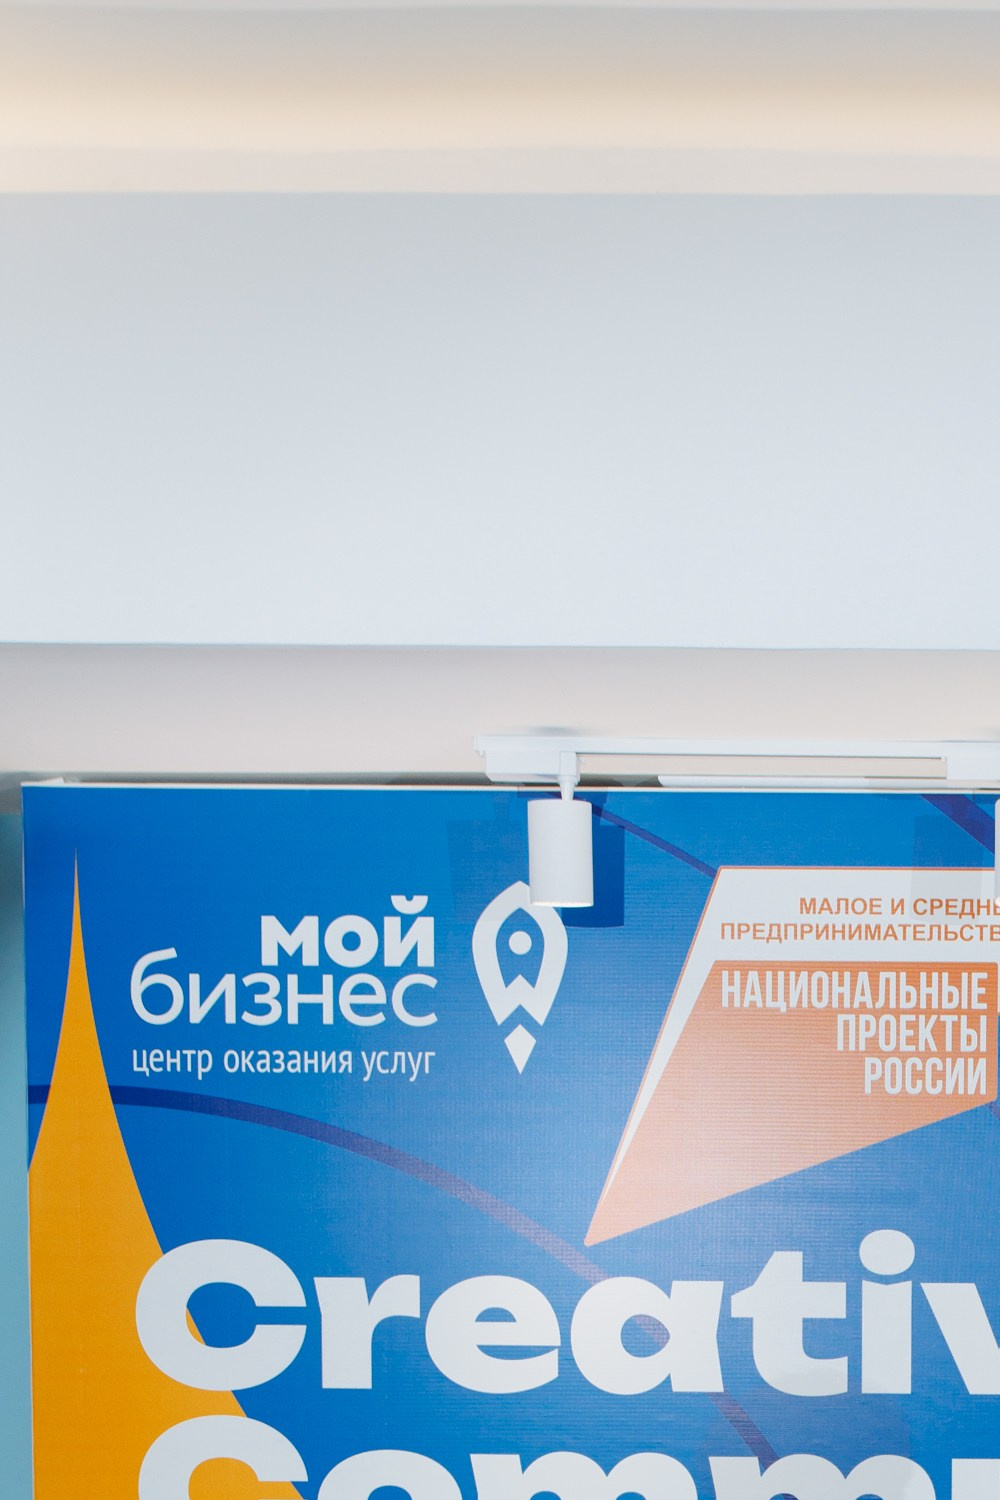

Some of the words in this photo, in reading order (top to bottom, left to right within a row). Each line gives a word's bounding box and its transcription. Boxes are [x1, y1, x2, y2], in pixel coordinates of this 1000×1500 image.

[799, 897, 883, 916] МАЛОЕ
[891, 898, 905, 916] И
[261, 895, 435, 968] мой
[130, 947, 438, 1027] бизнес
[721, 970, 988, 1012] НАЦИОНАЛЬНЫЕ
[837, 1014, 987, 1053] ПРОЕКТЫ
[132, 1048, 213, 1081] центр
[223, 1049, 353, 1074] оказания
[361, 1050, 436, 1082] услуг
[864, 1057, 987, 1095] РОССИИ
